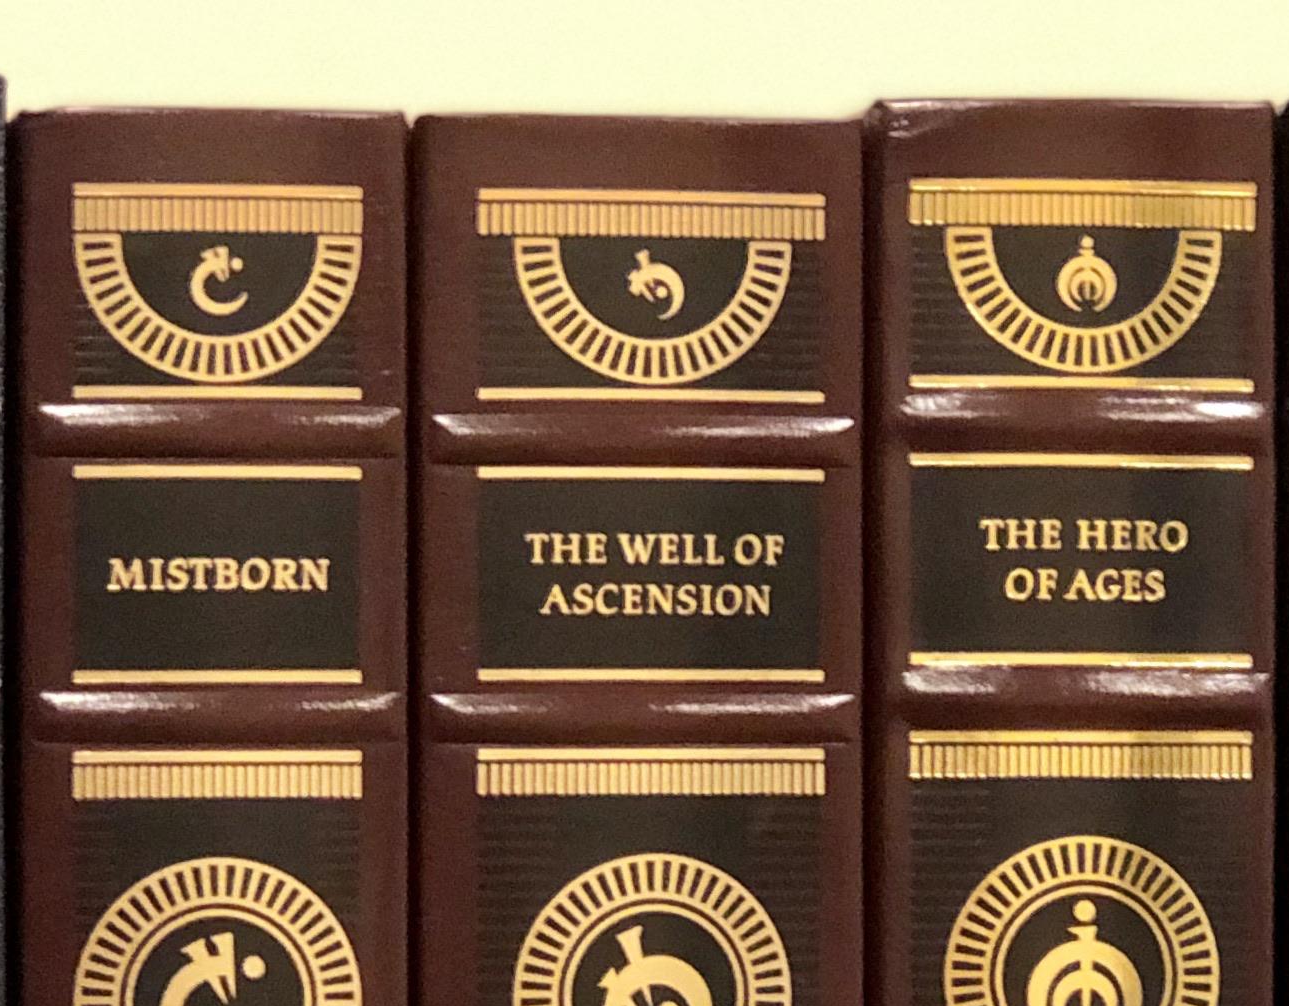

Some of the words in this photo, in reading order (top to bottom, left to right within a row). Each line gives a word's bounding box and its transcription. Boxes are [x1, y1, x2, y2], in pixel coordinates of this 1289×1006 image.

[523, 532, 608, 565] THE
[616, 532, 725, 566] WELL
[734, 533, 785, 566] OF
[979, 518, 1062, 551] THE
[1075, 518, 1189, 552] HERO
[107, 557, 330, 591] MISTBORN
[1005, 567, 1059, 601] OF
[1063, 568, 1166, 602] AGES
[538, 583, 771, 616] ASCENSION
